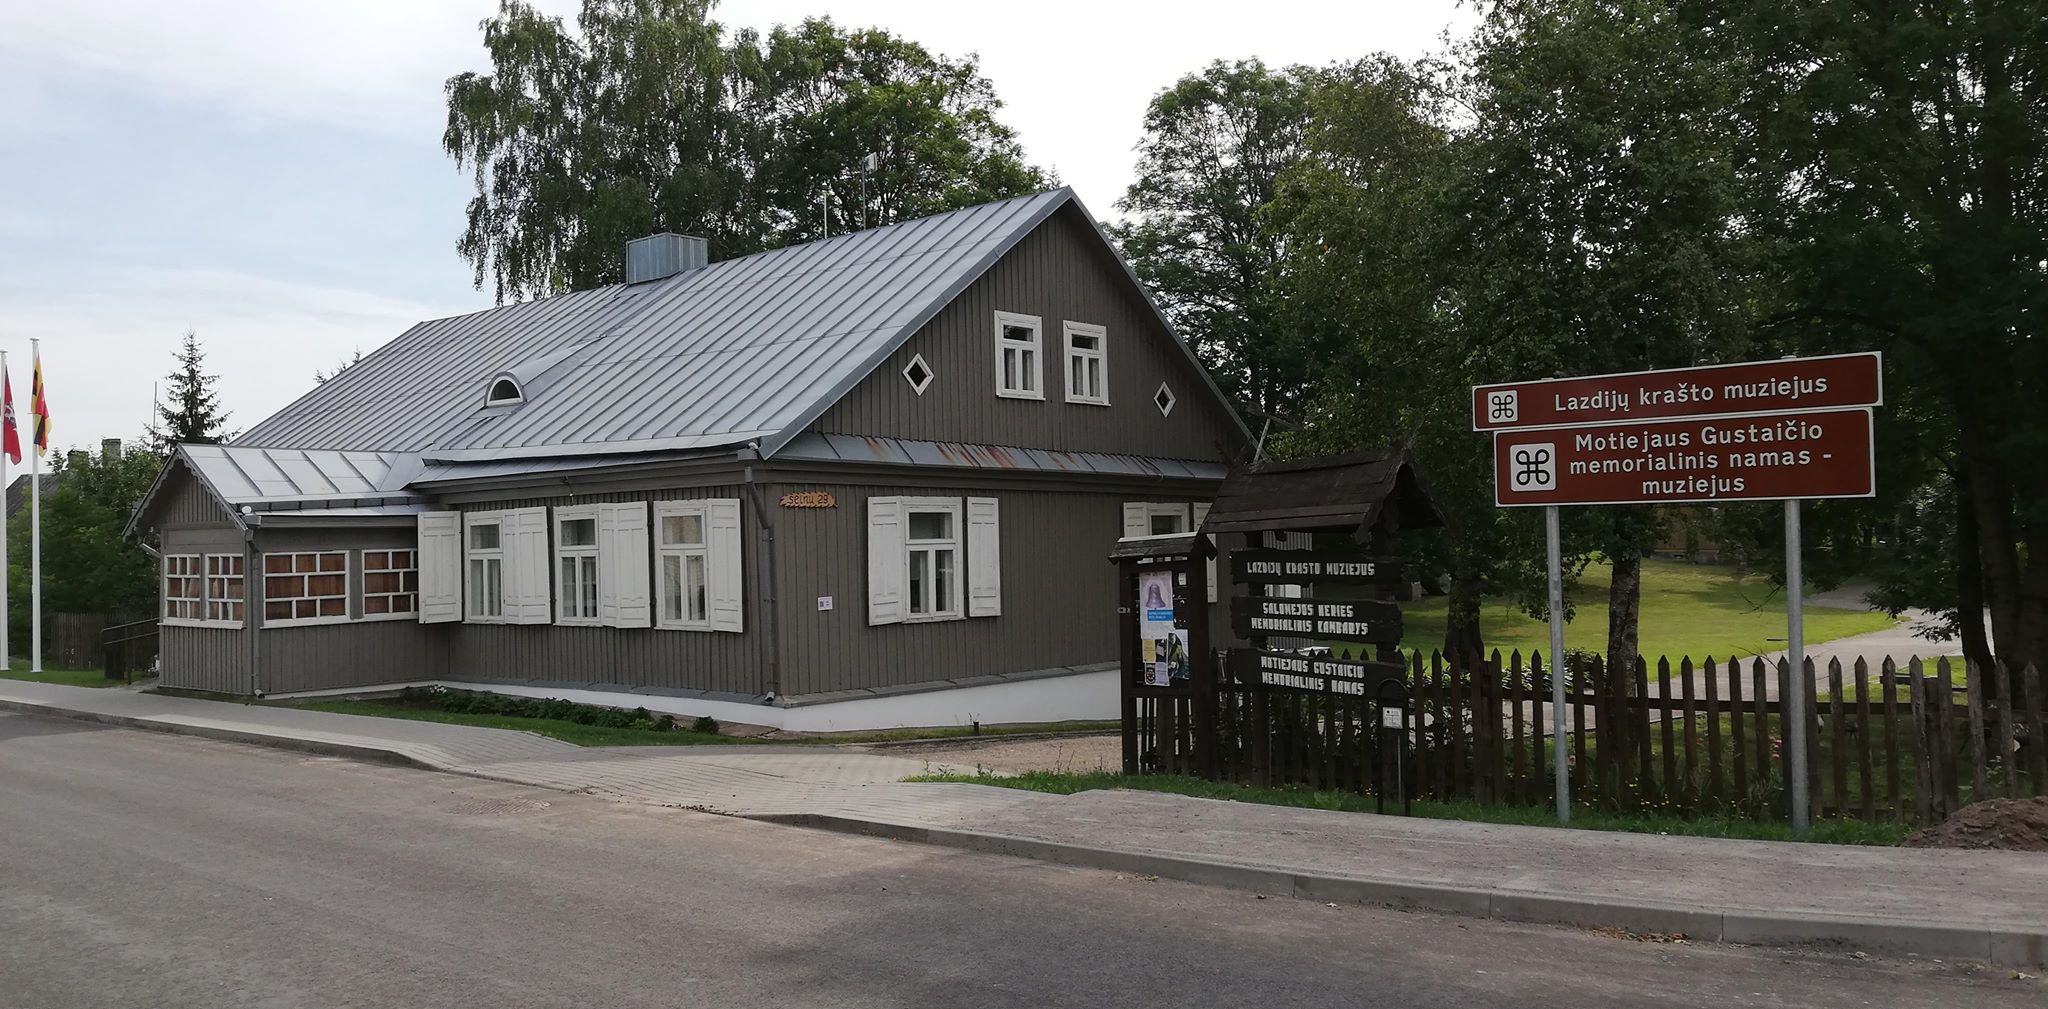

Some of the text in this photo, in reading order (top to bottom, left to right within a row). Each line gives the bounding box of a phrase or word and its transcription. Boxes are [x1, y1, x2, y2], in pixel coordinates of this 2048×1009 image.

[1555, 375, 1828, 412] Lazdijų krašto muziejus
[1575, 420, 1823, 454] Motiejaus Gustaičio
[1570, 451, 1719, 475] memorialinis
[1729, 450, 1811, 468] namas
[1642, 475, 1745, 497] muziejus
[818, 494, 829, 505] 29
[1326, 563, 1375, 576] MUZIEJUS
[1251, 618, 1368, 635] MEMORIALINIS KAMBARYS
[1261, 656, 1308, 672] MOTIEJAUS
[1262, 672, 1365, 695] MEMORIALINIS NAMAS
